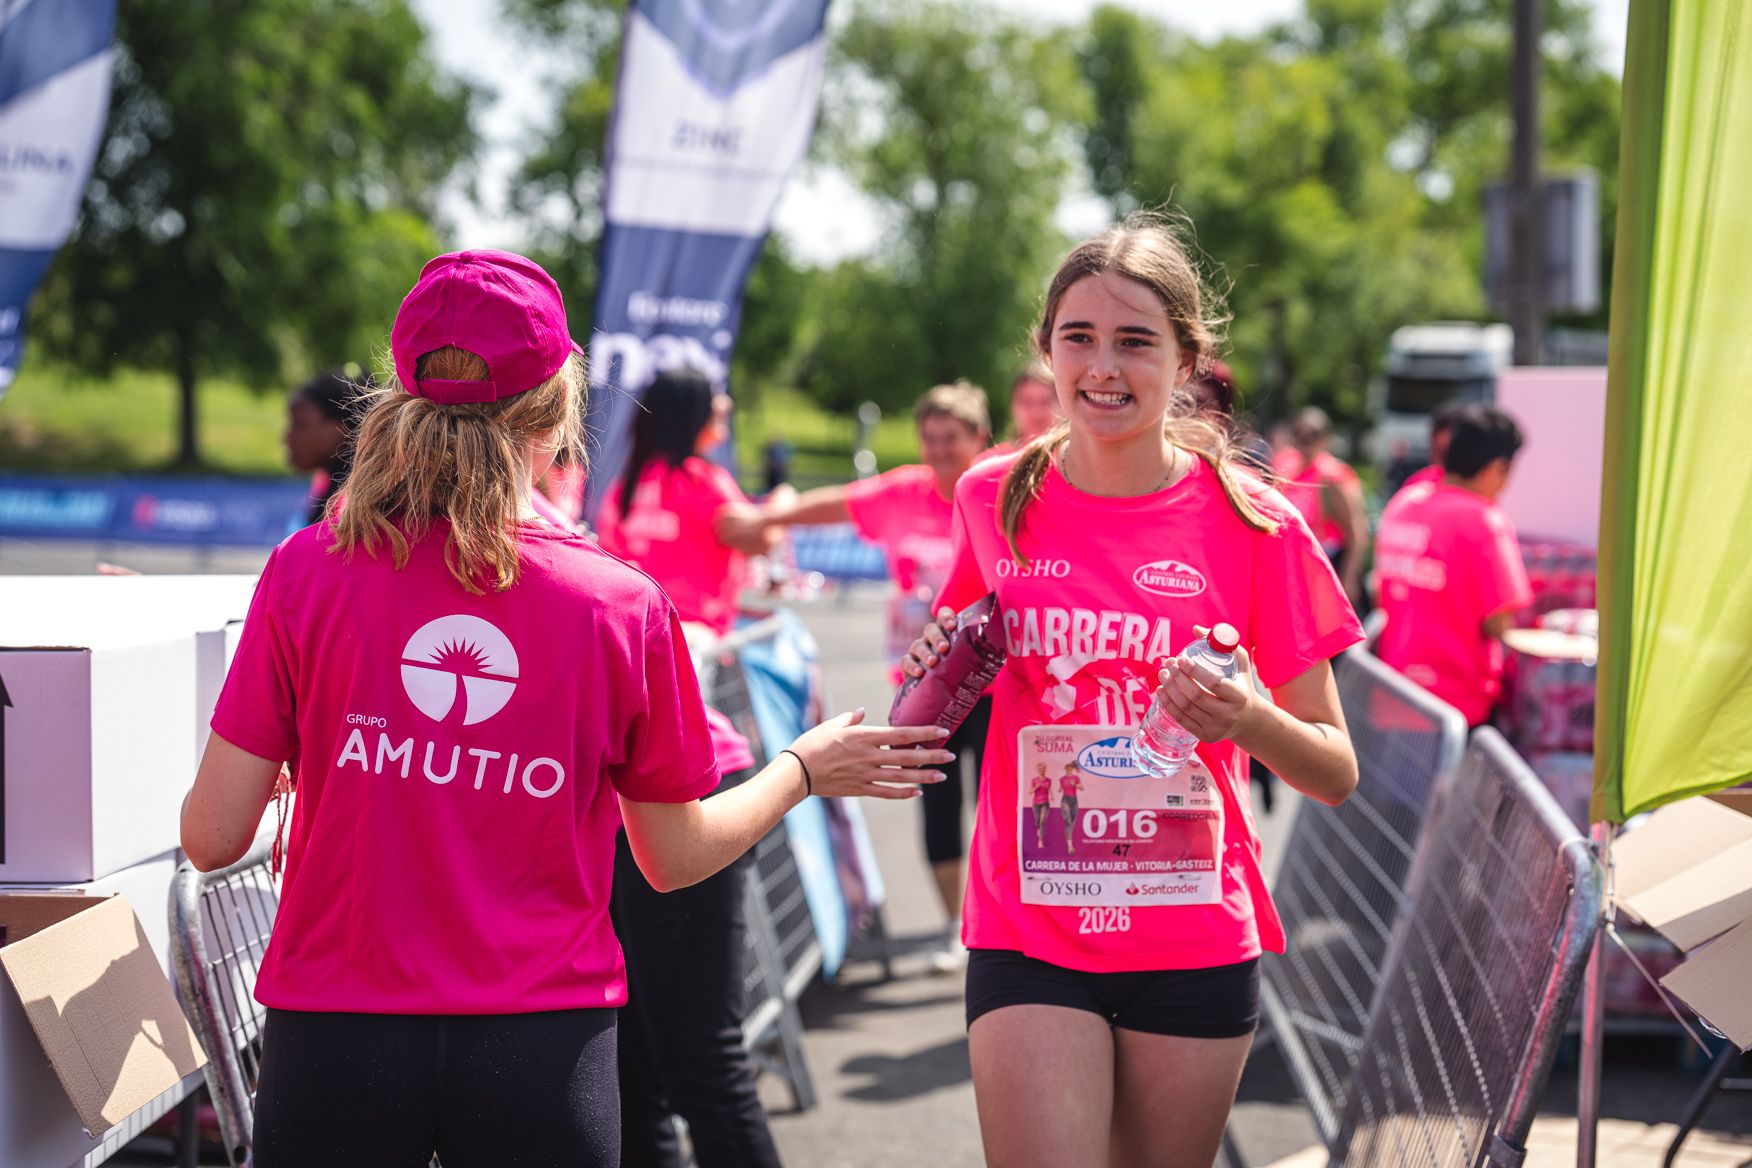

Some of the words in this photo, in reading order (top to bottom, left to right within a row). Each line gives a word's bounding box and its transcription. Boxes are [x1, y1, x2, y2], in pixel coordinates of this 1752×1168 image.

[996, 558, 1071, 578] OYSHO
[1139, 570, 1200, 591] ASTURIANA
[1003, 607, 1171, 664] CARRERA
[346, 713, 387, 728] GRUPO
[1036, 742, 1074, 753] SUMA
[337, 728, 565, 798] AMUTIO
[1085, 751, 1136, 768] ASTURI
[1082, 809, 1158, 838] 016
[1112, 844, 1130, 857] 47
[1025, 860, 1066, 871] CARRERA
[1068, 861, 1080, 871] DE
[1082, 861, 1095, 871] LA
[1096, 861, 1129, 871] MUJER
[1135, 859, 1213, 871] VITORIA-GASTEIZ
[1040, 881, 1102, 896] OYSHO
[1141, 882, 1200, 895] Santander
[1078, 906, 1130, 934] 2026
